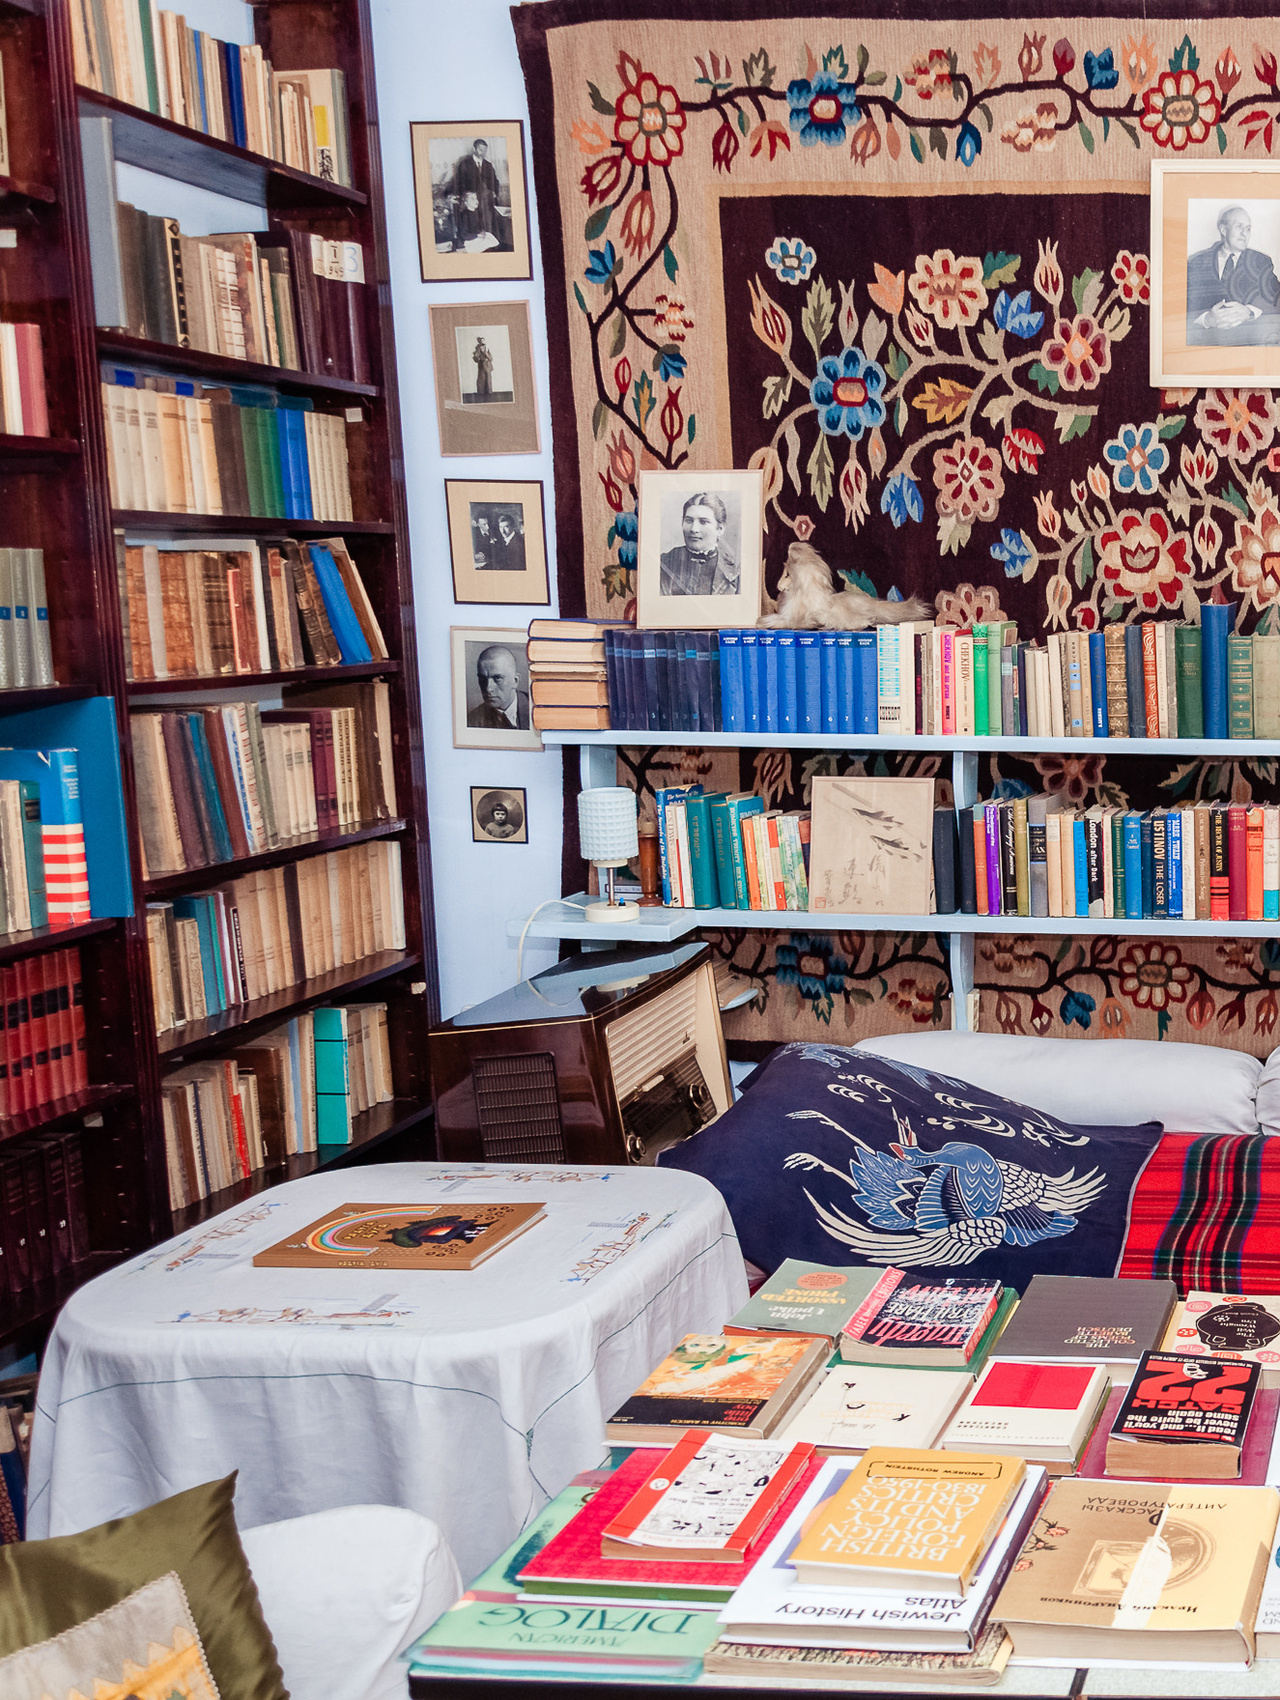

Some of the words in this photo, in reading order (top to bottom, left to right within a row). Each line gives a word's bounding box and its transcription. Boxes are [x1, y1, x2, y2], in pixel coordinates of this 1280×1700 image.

[346, 246, 359, 273] 3
[944, 635, 952, 664] CHEKHOV
[960, 643, 970, 681] CHEKHOV
[730, 808, 738, 837] HOMICIDE
[1172, 820, 1181, 839] MARK
[1089, 821, 1099, 849] London
[1153, 821, 1166, 860] USTINOV
[1215, 826, 1223, 846] RECTOR
[732, 839, 740, 864] TRINITY
[1090, 851, 1098, 867] after
[1172, 841, 1181, 860] TWAIN
[659, 856, 667, 880] Dolphin
[1076, 844, 1084, 880] BEERBOHM
[1215, 853, 1223, 872] JUSTIN
[1155, 865, 1164, 881] THE
[736, 881, 744, 900] STOUT
[1155, 882, 1164, 906] LOSER
[768, 1306, 824, 1315] Updike
[769, 1311, 811, 1320] John
[883, 1302, 932, 1318] HARE
[933, 1305, 979, 1319] CYRIL
[849, 1314, 869, 1336] FABER
[867, 1320, 965, 1346] Tragedy
[1135, 1360, 1252, 1405] 22
[723, 1410, 752, 1418] little
[731, 1404, 758, 1412] boy
[1131, 1398, 1242, 1415] CATCH
[1167, 1409, 1204, 1419] again
[1126, 1414, 1148, 1423] the
[1150, 1415, 1184, 1425] quite
[1186, 1418, 1202, 1427] be
[1204, 1419, 1238, 1428] never
[1205, 1412, 1240, 1420] same
[885, 1464, 939, 1473] ROTHSTEIN
[943, 1469, 984, 1477] ANDREW
[866, 1475, 986, 1496] 1830-1950
[856, 1484, 981, 1508] CRITICS
[1087, 1497, 1228, 1510] ЛИТЕРАТУРОВЕДА
[845, 1498, 909, 1515] ITS
[910, 1502, 974, 1520] AND
[841, 1512, 961, 1534] POLICY
[820, 1524, 966, 1549] FOREIGN
[818, 1539, 950, 1562] BRITISH
[774, 1603, 865, 1620] History
[904, 1596, 968, 1611] Atlas
[478, 1607, 699, 1635] DIALOG
[871, 1608, 961, 1623] Jewish
[509, 1632, 630, 1648] AMERICAN
